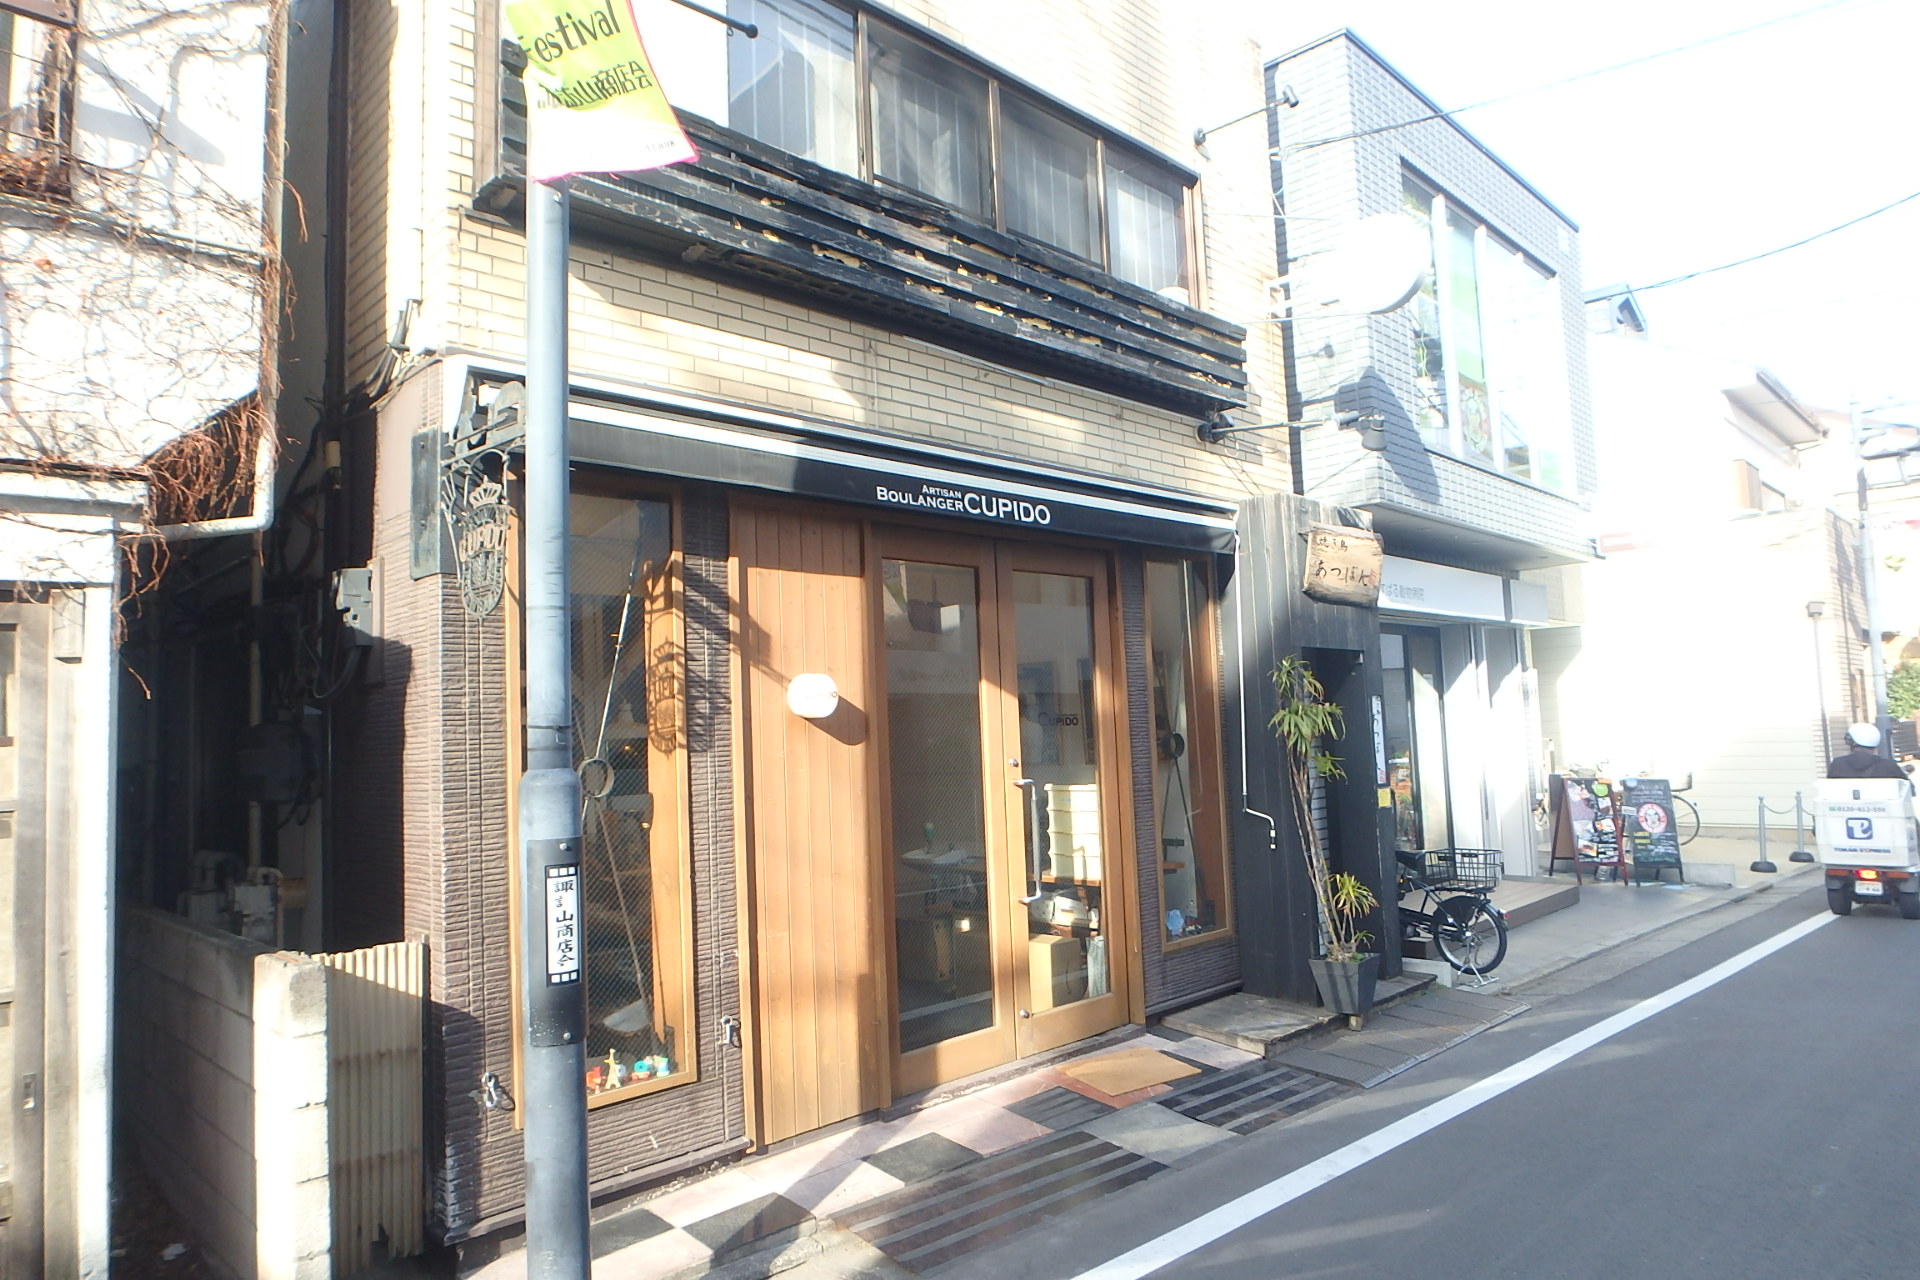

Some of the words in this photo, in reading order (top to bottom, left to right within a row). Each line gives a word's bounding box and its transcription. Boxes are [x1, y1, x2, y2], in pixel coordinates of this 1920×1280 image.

[921, 484, 962, 499] ARTISAN
[875, 486, 965, 512] BOULANGER
[963, 492, 1051, 525] CUPIDO
